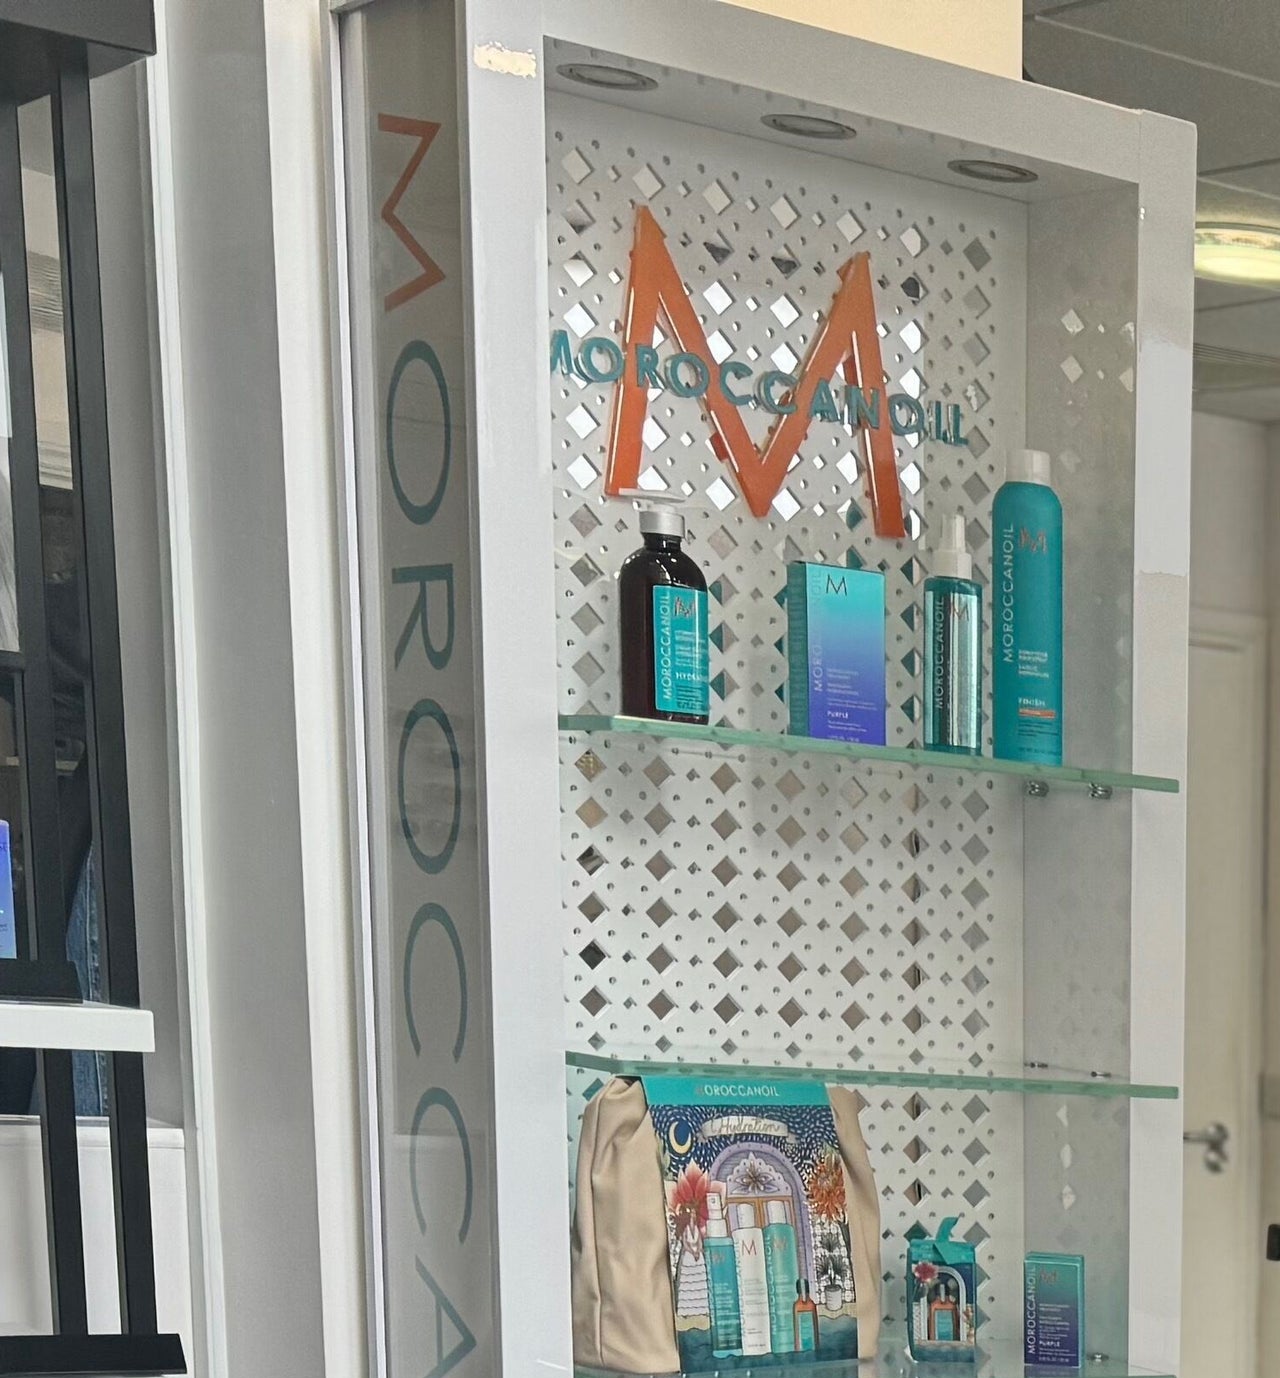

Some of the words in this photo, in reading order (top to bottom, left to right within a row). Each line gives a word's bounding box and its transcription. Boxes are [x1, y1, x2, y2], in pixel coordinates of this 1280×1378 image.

[660, 592, 672, 701] MOROCCANOIL
[1003, 523, 1015, 664] MOROCCANOIL
[932, 598, 946, 710] MOROCCANOIL
[1026, 1265, 1036, 1354] MOROCCANOIL
